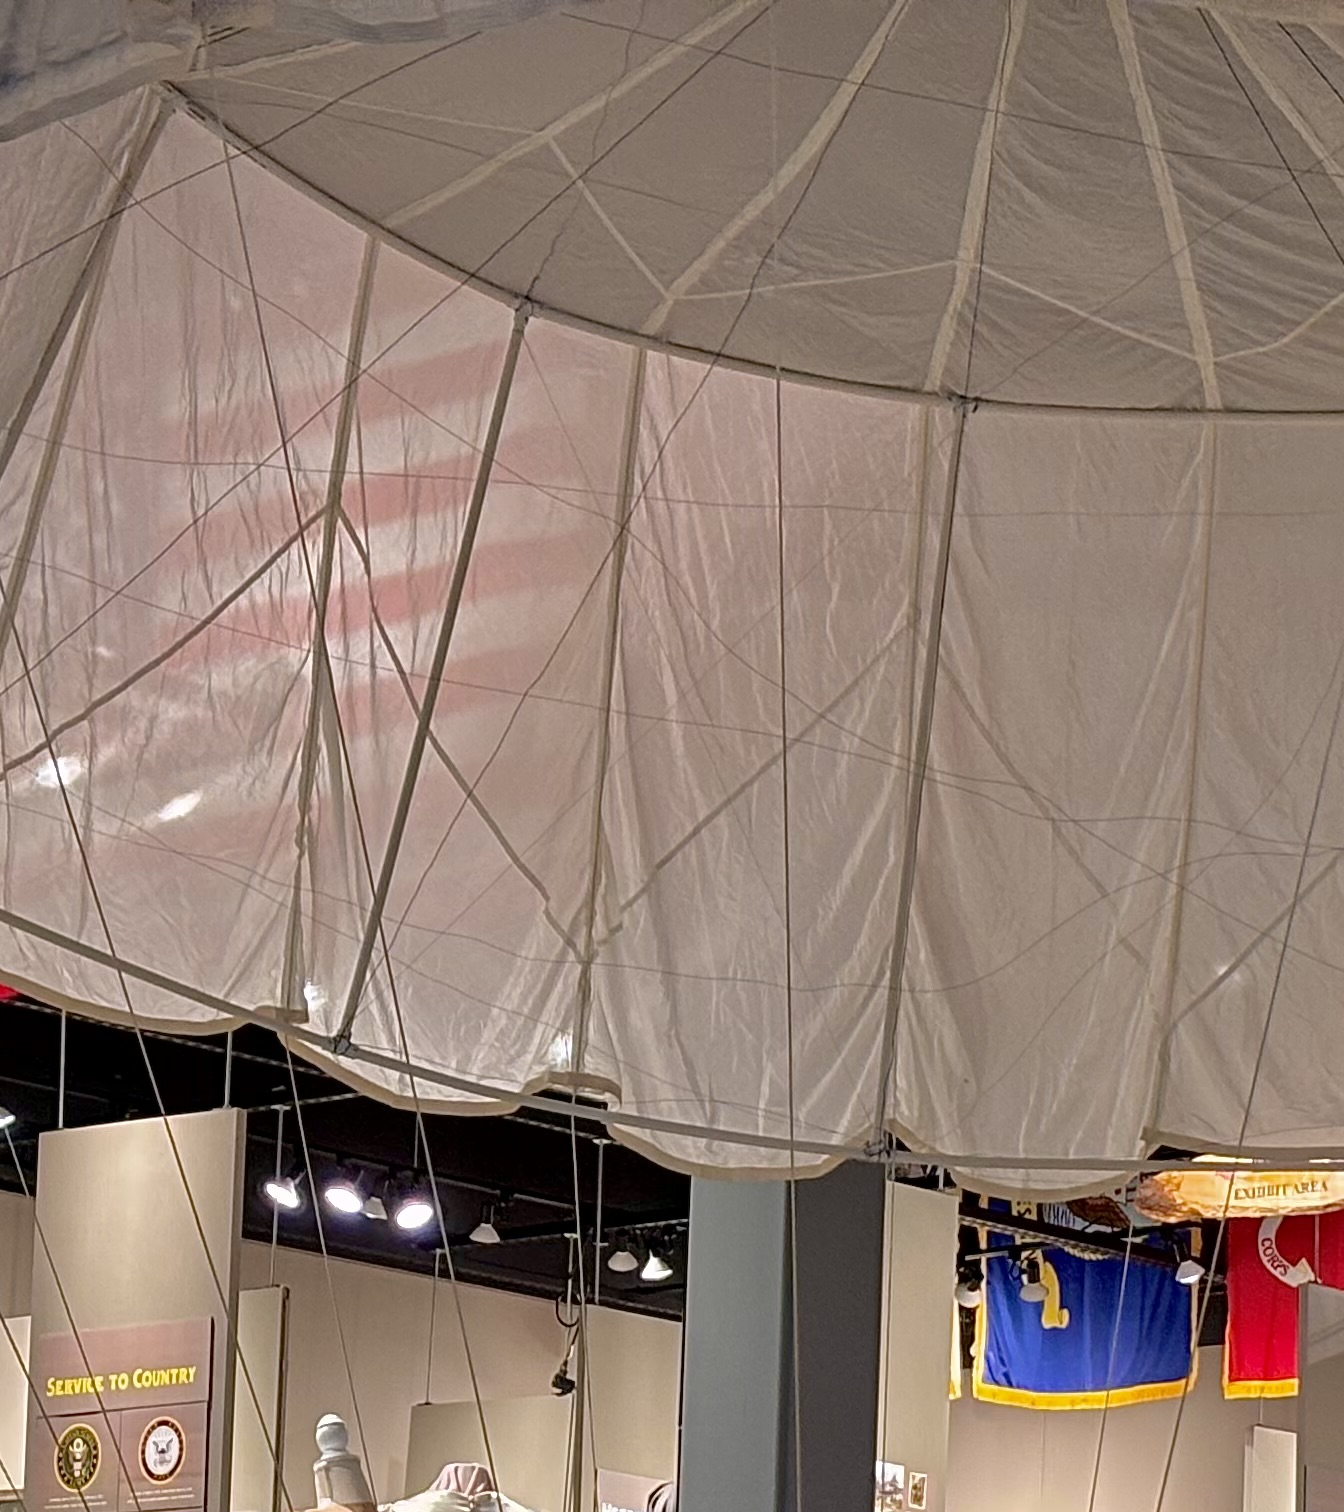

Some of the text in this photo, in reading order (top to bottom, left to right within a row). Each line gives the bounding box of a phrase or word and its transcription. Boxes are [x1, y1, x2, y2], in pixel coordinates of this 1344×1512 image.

[1260, 1237, 1290, 1277] CORPS
[46, 1366, 197, 1397] SERVICE TO COUNTRY
